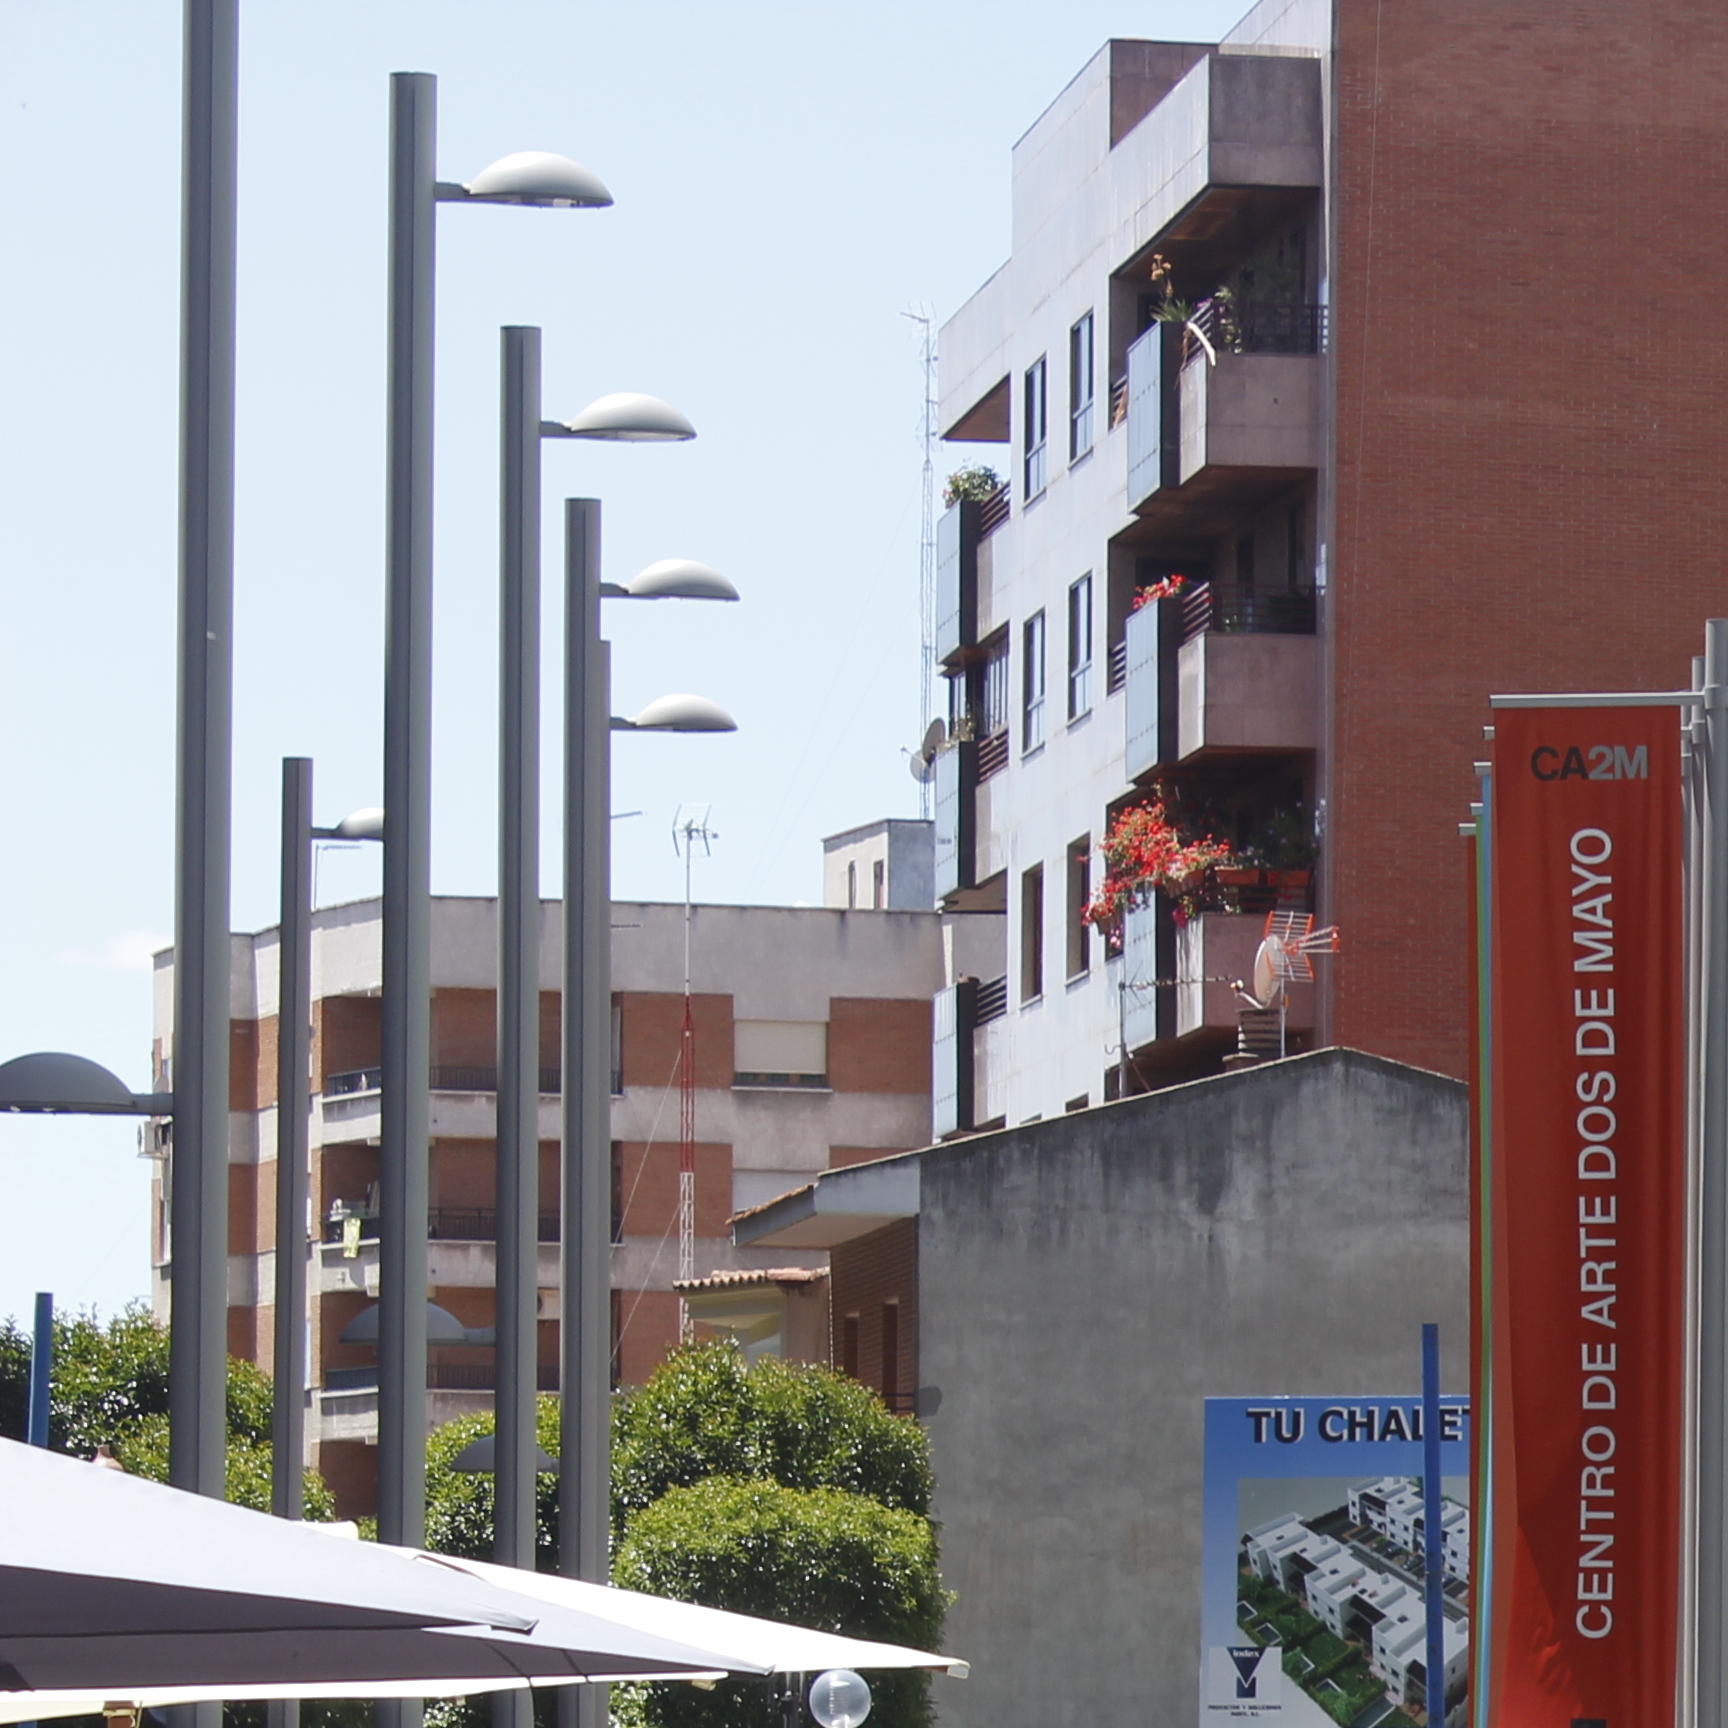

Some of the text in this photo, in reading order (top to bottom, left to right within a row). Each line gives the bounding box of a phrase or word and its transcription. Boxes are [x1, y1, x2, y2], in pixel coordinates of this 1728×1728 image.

[1530, 744, 1649, 782] CA2M
[1569, 827, 1618, 1641] CENTRO DE ARTE DOS DE MAYO
[1246, 1406, 1306, 1444] TU
[1317, 1405, 1471, 1444] CHALE
